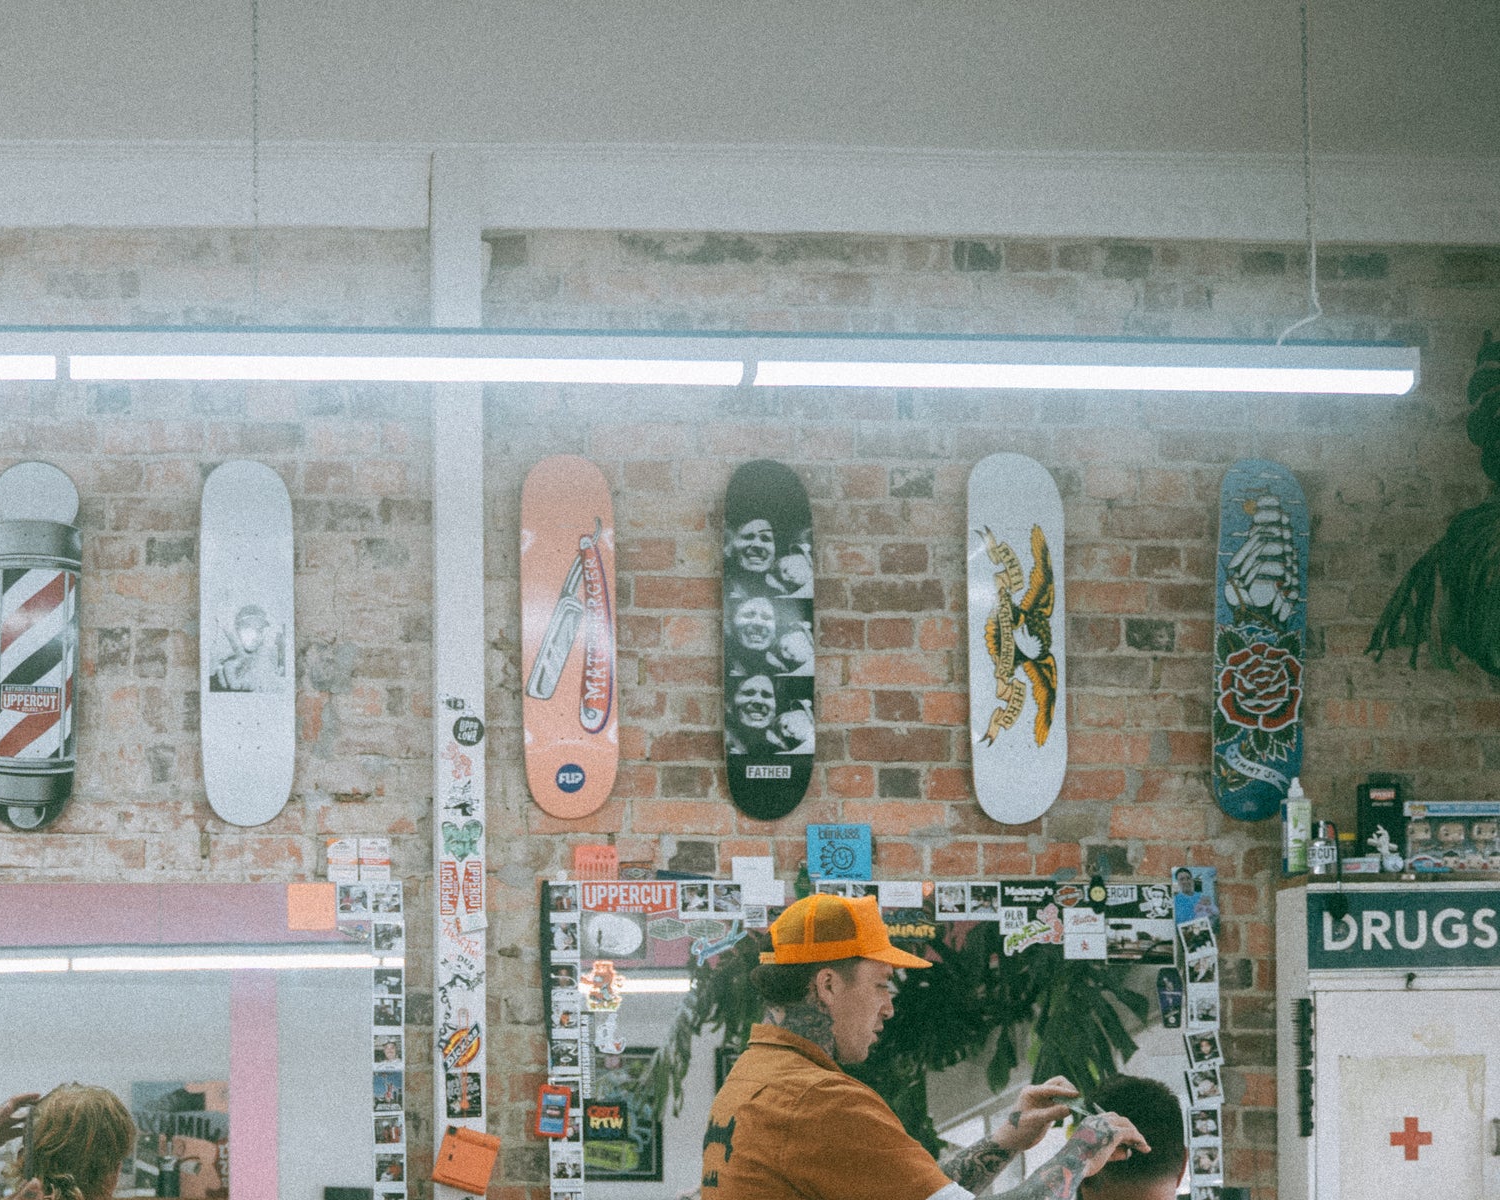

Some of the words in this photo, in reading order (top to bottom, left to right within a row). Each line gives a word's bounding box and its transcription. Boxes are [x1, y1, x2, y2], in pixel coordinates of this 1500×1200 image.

[1001, 547, 1022, 586] ANTI
[3, 693, 57, 710] UPPERCUT
[1003, 686, 1023, 725] HERO
[747, 767, 790, 778] FATHER
[583, 883, 675, 909] UPPERCUT
[1322, 907, 1498, 951] DRUGS
[589, 1116, 624, 1130] RTW
